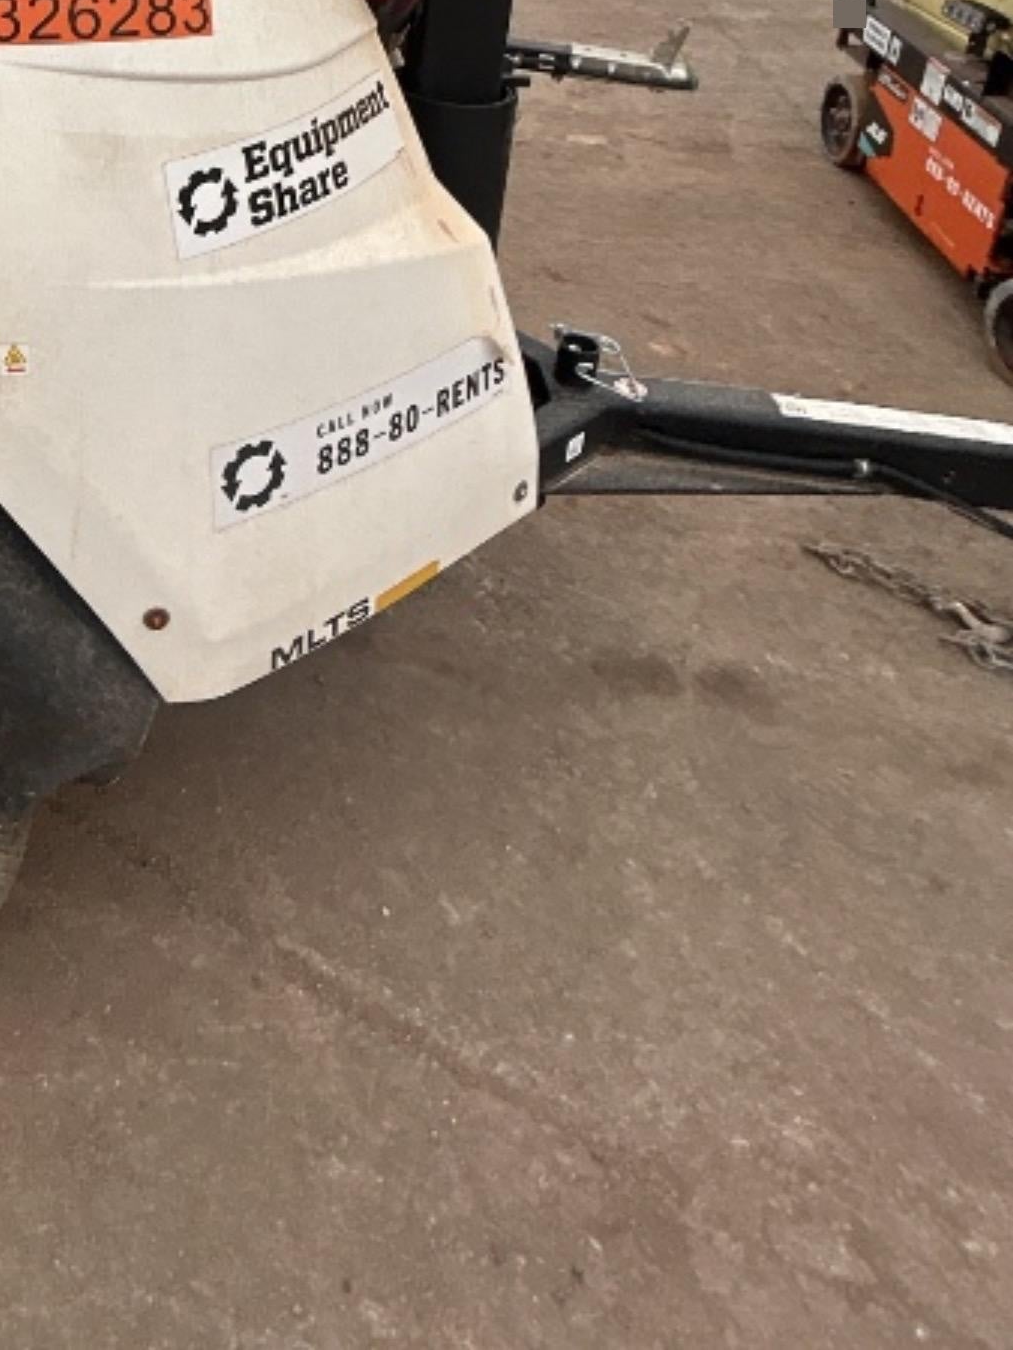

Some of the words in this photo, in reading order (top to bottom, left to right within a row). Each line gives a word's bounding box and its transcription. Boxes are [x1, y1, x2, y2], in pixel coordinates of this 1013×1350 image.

[241, 80, 390, 183] Equipment
[247, 160, 349, 227] Share
[316, 412, 354, 439] CALL
[361, 393, 394, 421] NOW
[316, 357, 505, 475] 888-80-RENTS
[270, 596, 370, 670] MLTS
